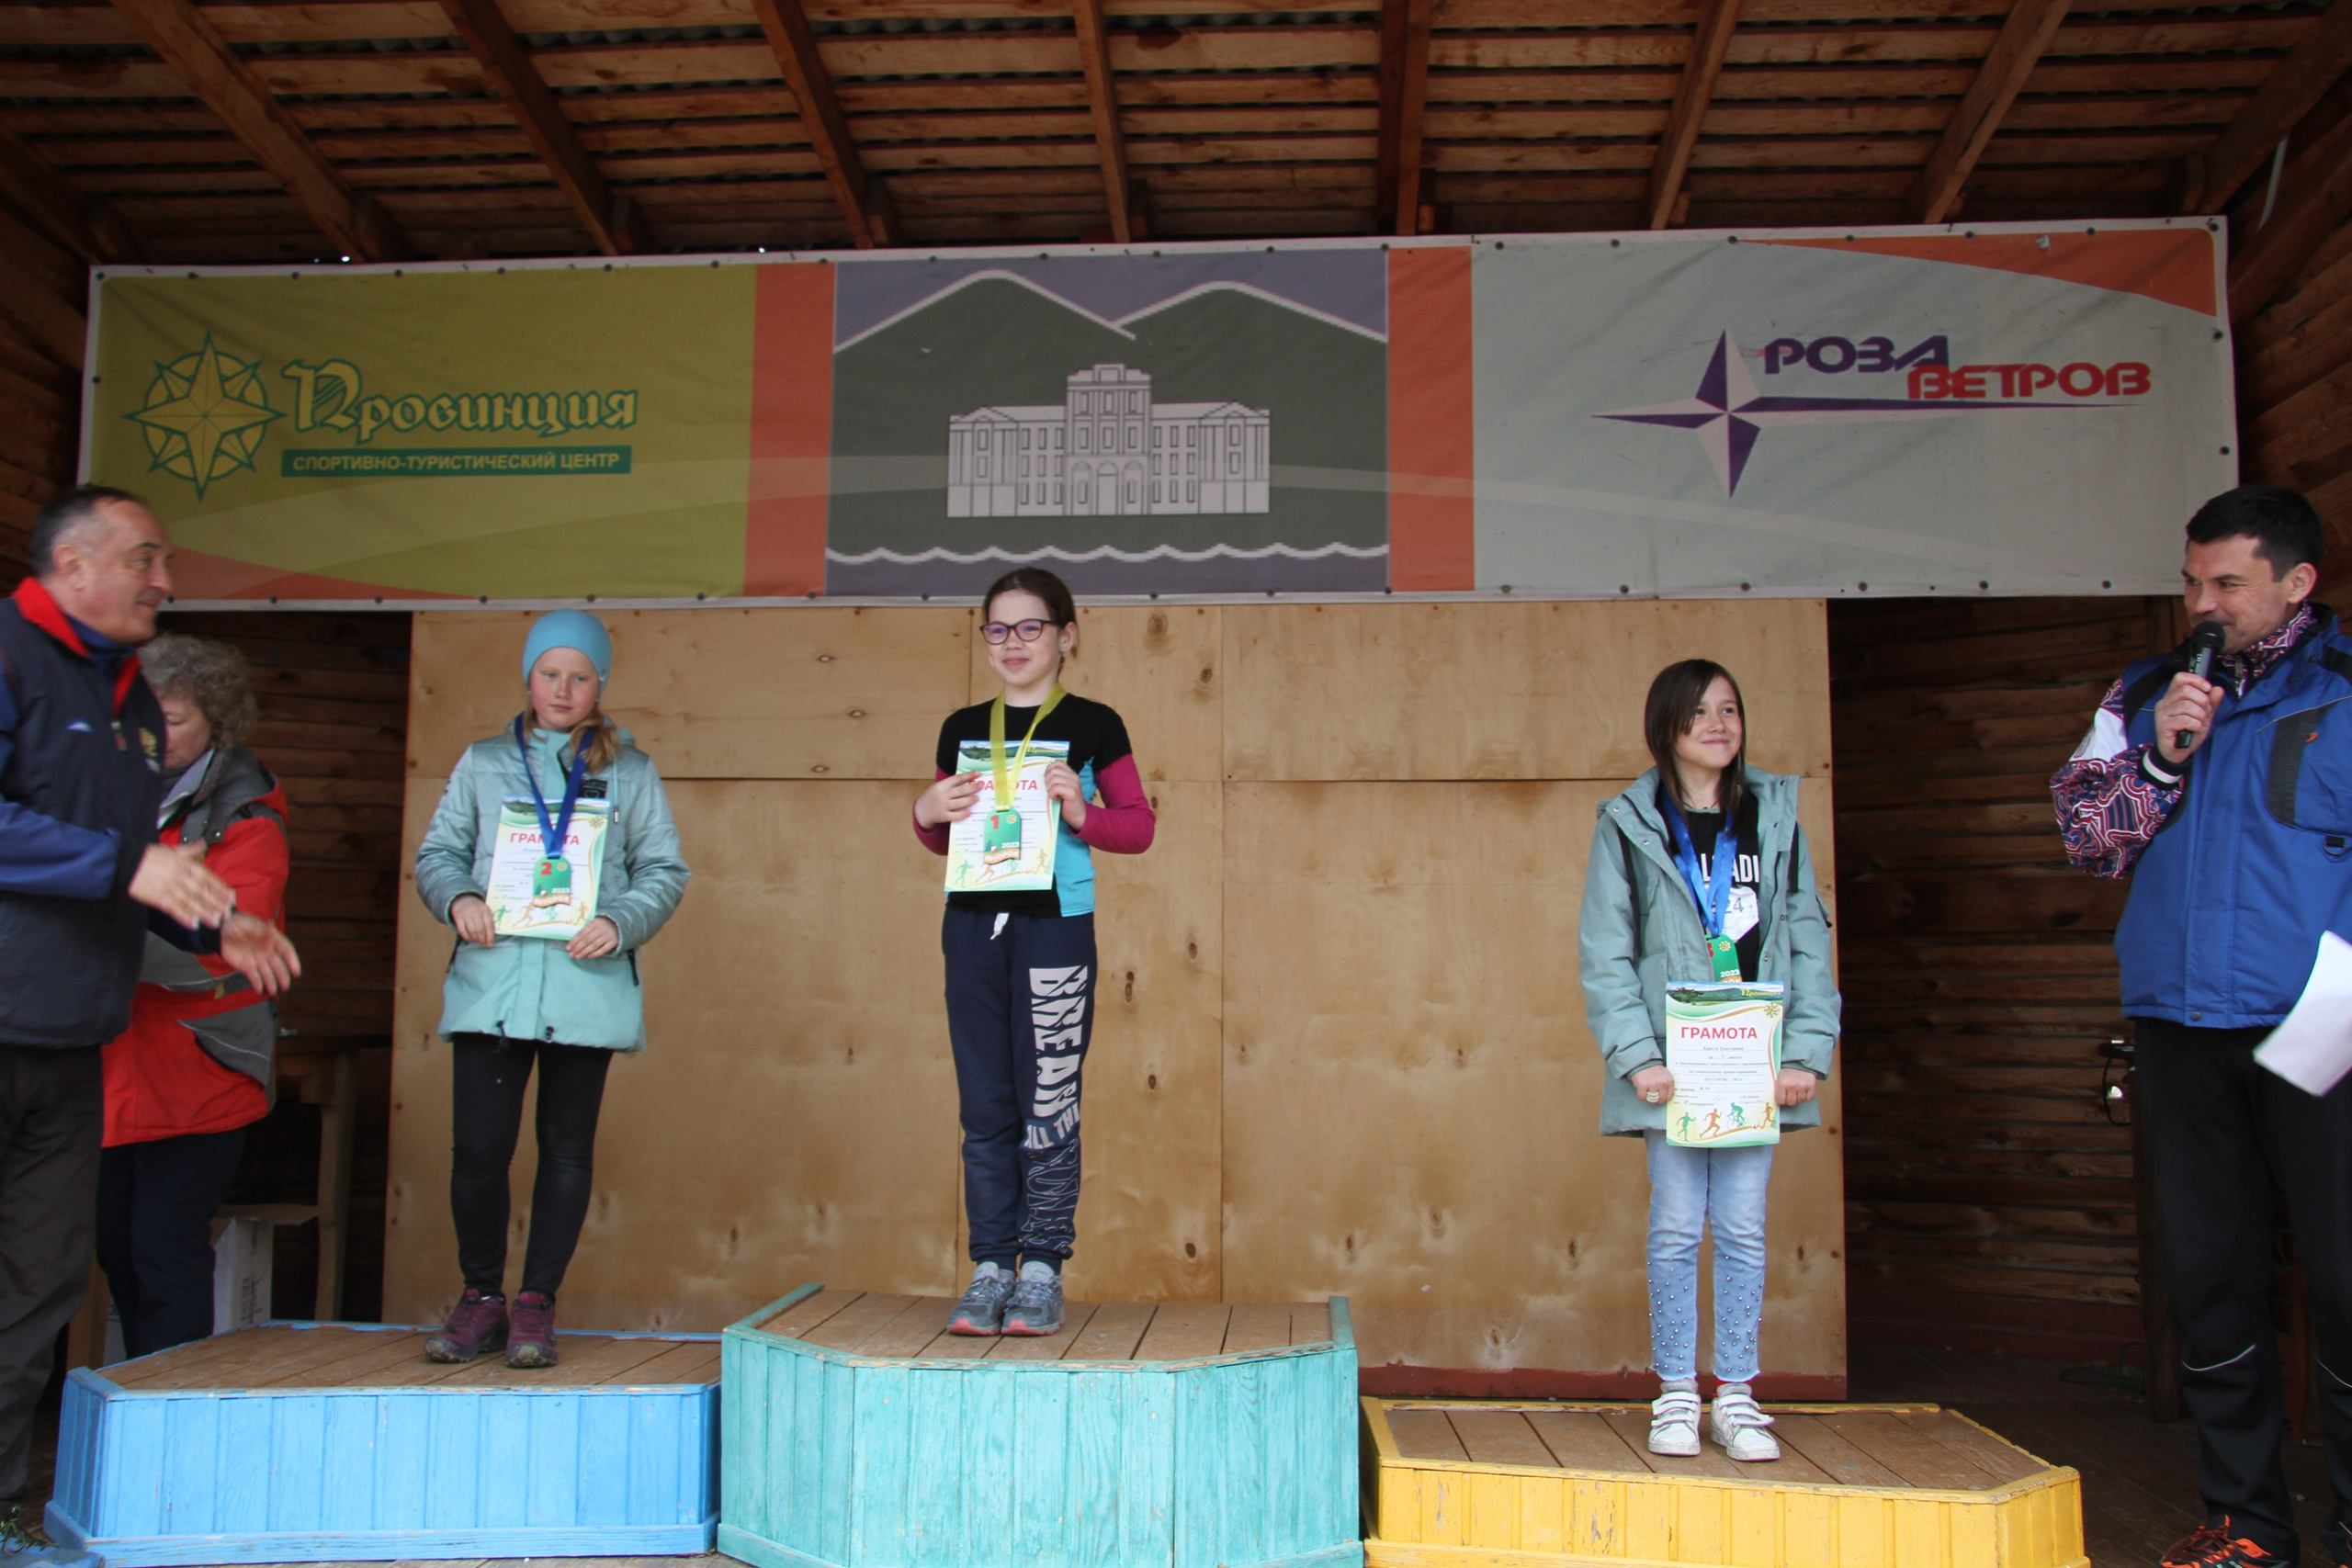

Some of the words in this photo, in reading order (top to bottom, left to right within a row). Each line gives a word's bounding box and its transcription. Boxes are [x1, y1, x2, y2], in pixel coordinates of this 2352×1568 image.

[1764, 334, 1949, 374] РОЗА
[1907, 361, 2152, 400] ВЕТРОВ
[280, 358, 639, 445] Провинция
[291, 450, 557, 472] СПОРТИВНО-ТУРИСТИЧЕСКИЙ
[560, 450, 620, 470] ЦЕНТР
[510, 832, 580, 845] ГРАТА
[539, 862, 552, 875] 2
[1720, 969, 1741, 978] 2023
[1029, 964, 1089, 1118] BREAK
[1681, 1027, 1758, 1039] ГРАМОТА
[1023, 1124, 1055, 1150] ALL
